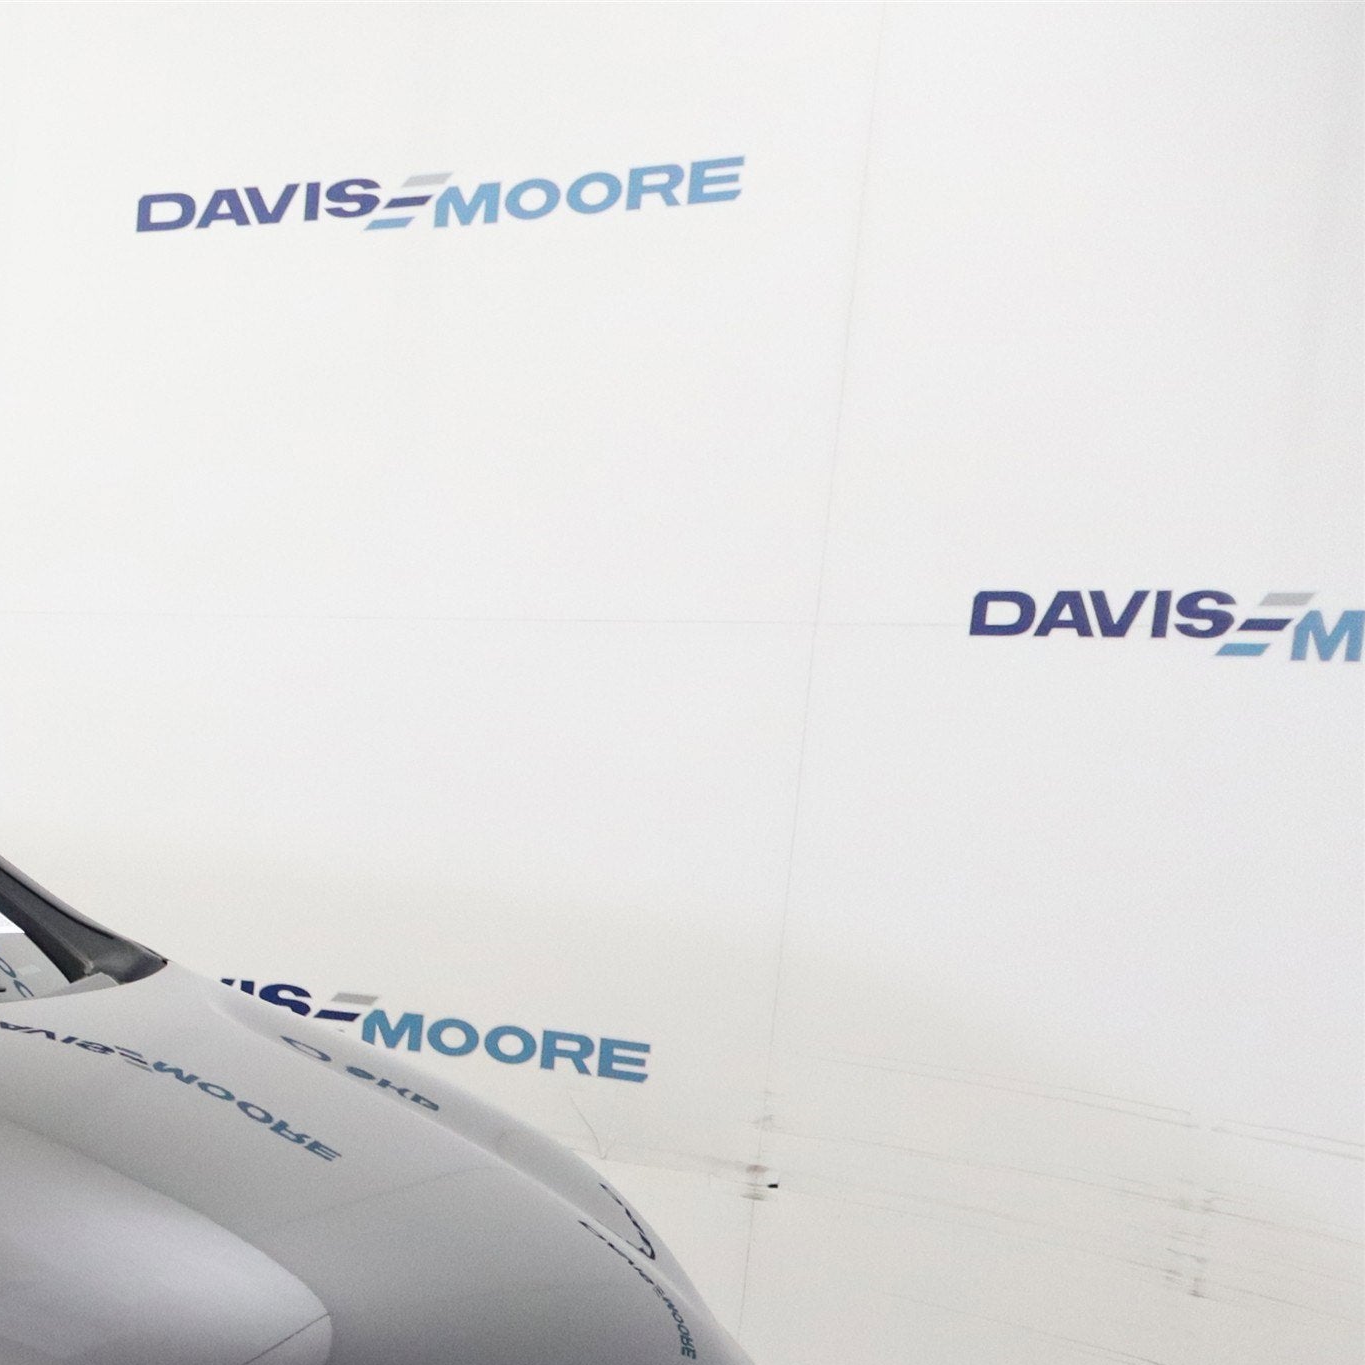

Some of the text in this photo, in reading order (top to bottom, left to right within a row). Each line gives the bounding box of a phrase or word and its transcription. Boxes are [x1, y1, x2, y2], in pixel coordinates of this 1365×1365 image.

[136, 156, 745, 232] DAVIS MOORE
[969, 590, 1237, 638] DAVIS
[362, 1009, 651, 1083] MOORE
